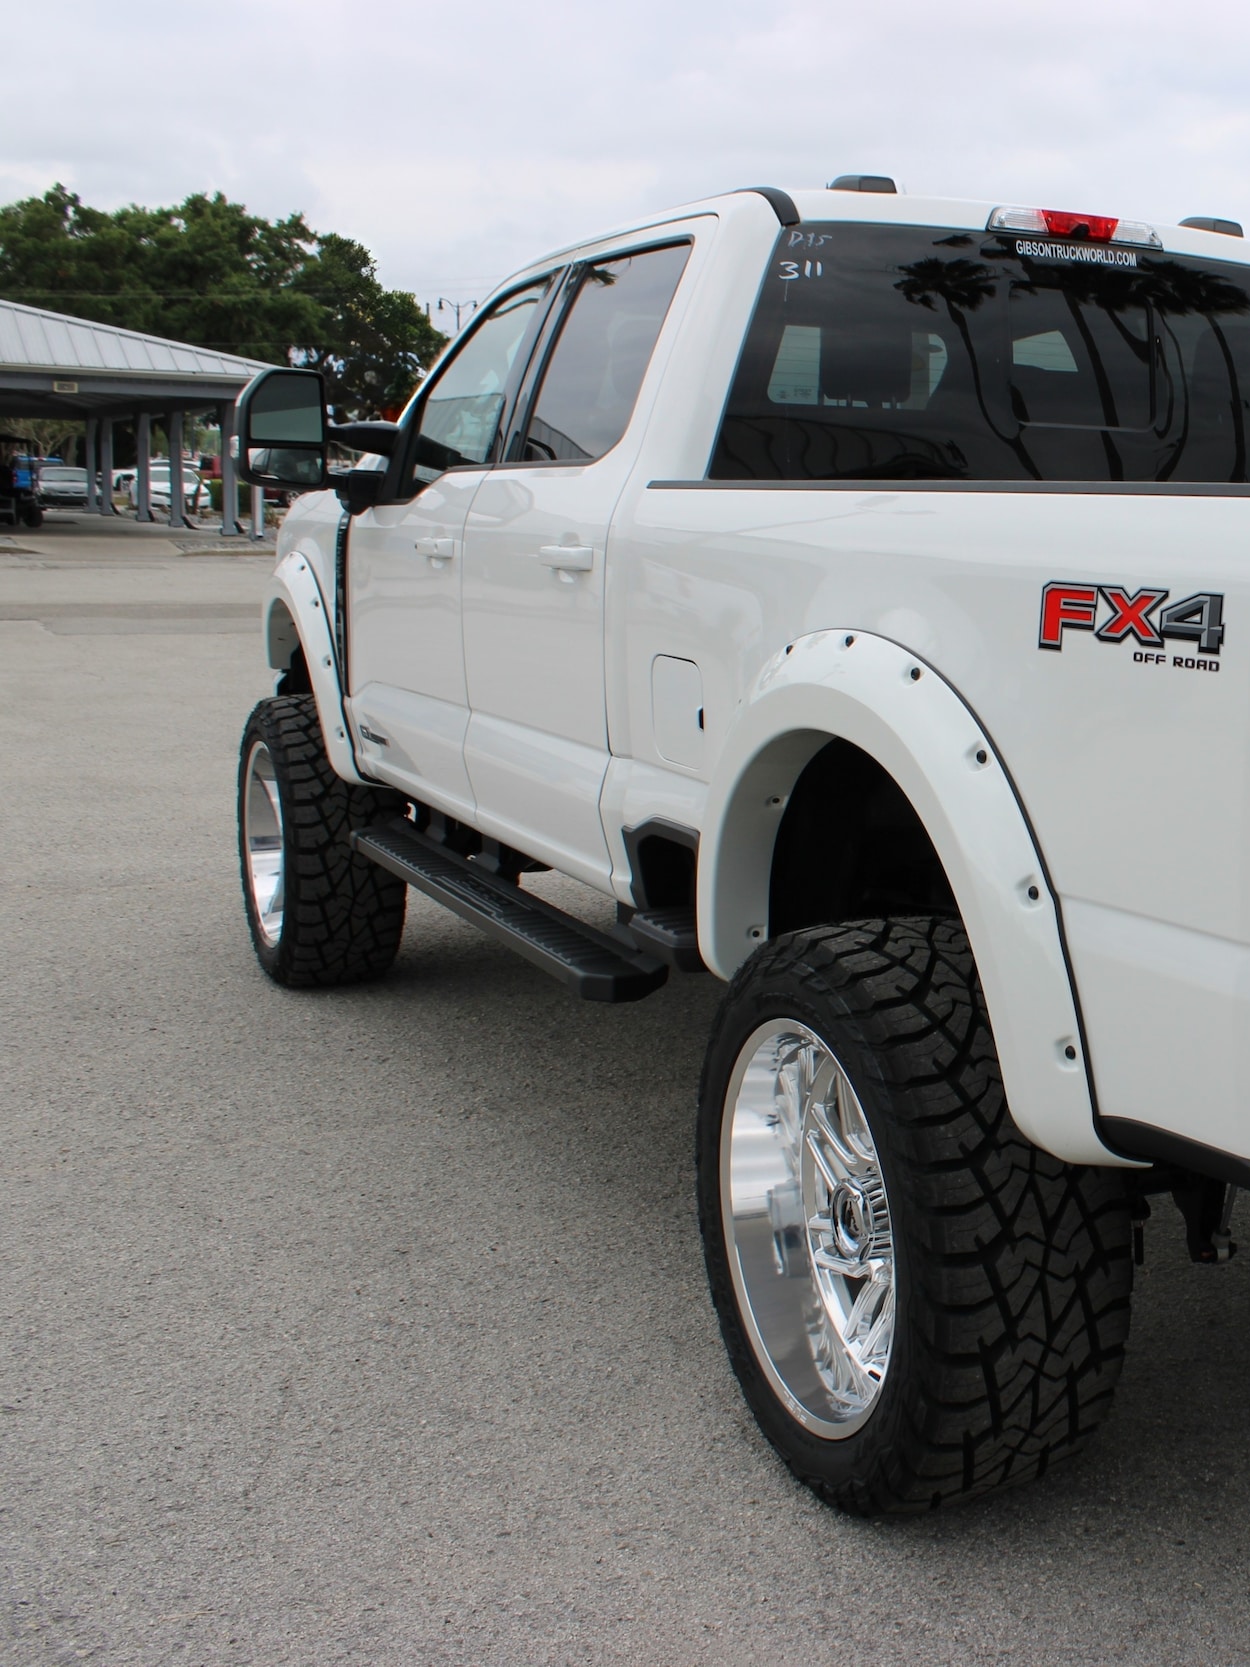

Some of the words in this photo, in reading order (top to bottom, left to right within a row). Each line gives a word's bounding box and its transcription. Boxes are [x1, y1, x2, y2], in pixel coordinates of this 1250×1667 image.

[1015, 240, 1137, 267] GIBSONTRUCKWORLD.COM
[778, 259, 822, 280] 311
[1038, 580, 1225, 655] FX4
[1133, 651, 1166, 665] OFF
[1172, 656, 1220, 672] ROAD
